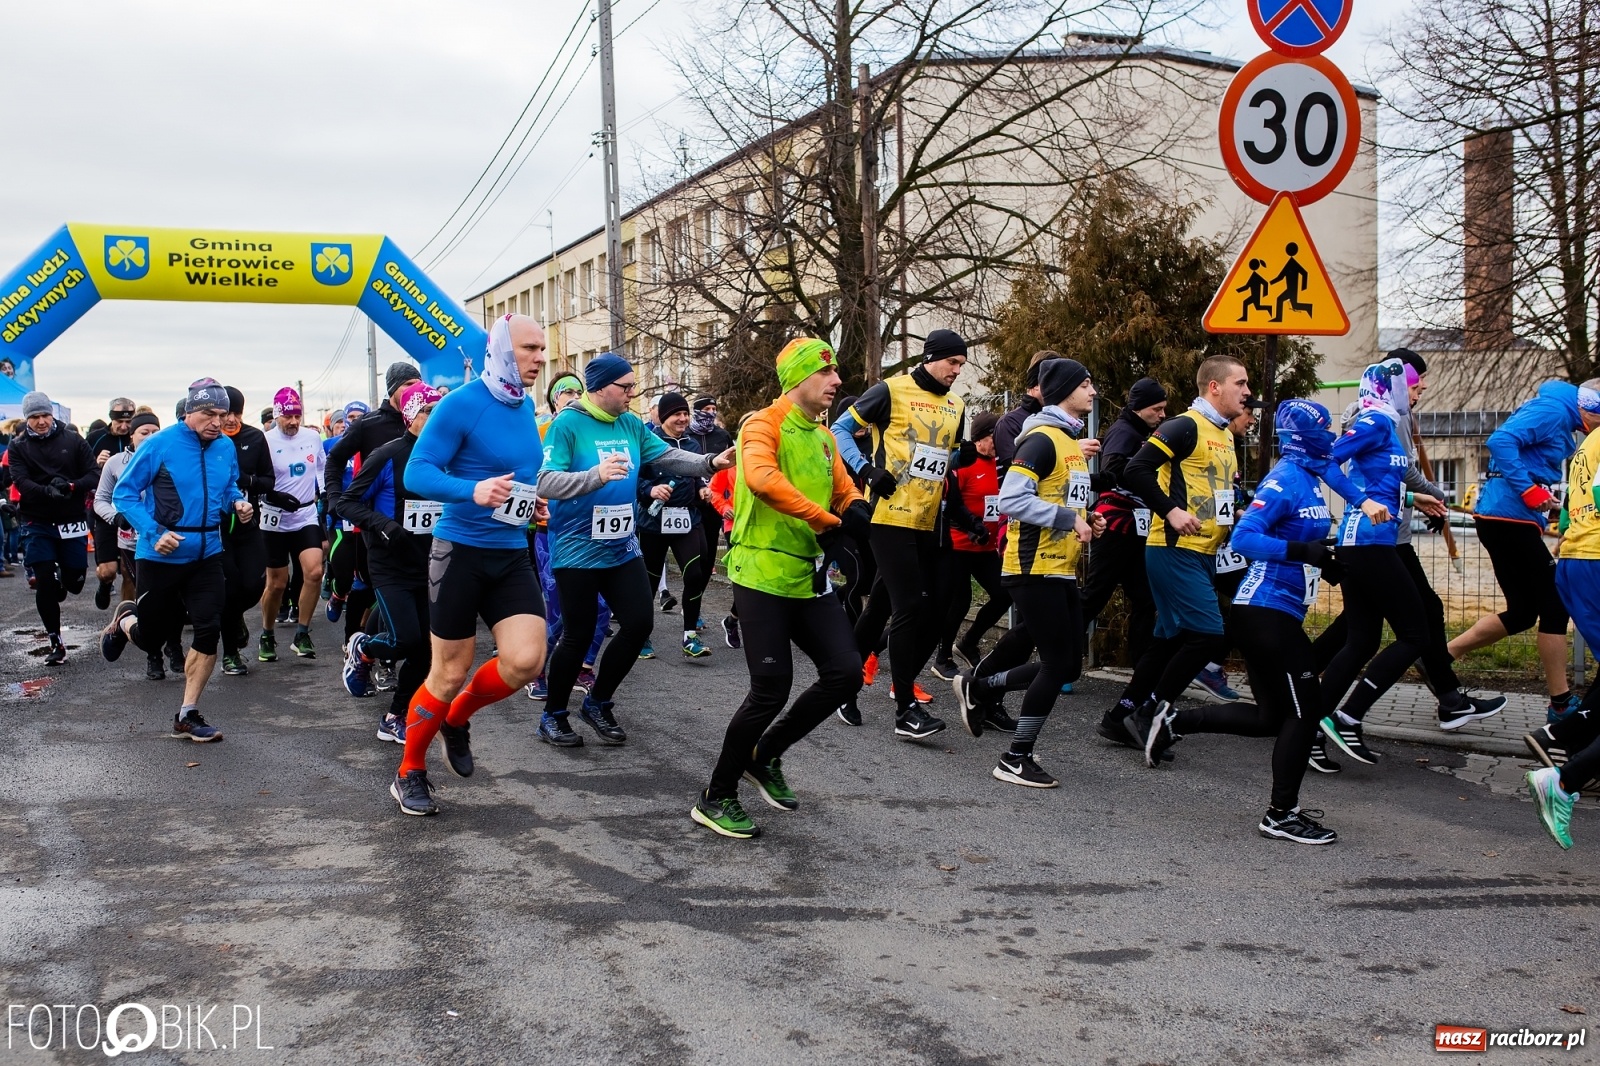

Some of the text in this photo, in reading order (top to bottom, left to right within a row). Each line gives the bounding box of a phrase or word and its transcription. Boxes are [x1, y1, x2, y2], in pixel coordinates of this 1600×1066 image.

[1243, 88, 1339, 167] 30
[190, 237, 273, 252] Gmina
[26, 248, 71, 288] ludzi
[168, 252, 295, 270] Pietrowice
[187, 271, 279, 287] Wielkie
[1, 269, 86, 343] aktywnych
[384, 260, 465, 338] Gmina ludzi
[371, 278, 448, 351] aktywnych
[914, 456, 946, 476] 443
[504, 497, 535, 519] 186
[1219, 502, 1234, 518] 4
[61, 522, 87, 535] 420
[263, 513, 280, 527] 19
[408, 512, 443, 528] 187
[596, 515, 632, 534] 197
[663, 517, 690, 530] 460
[1138, 518, 1151, 532] 3
[1216, 551, 1243, 568] 215
[1308, 576, 1321, 598] 1
